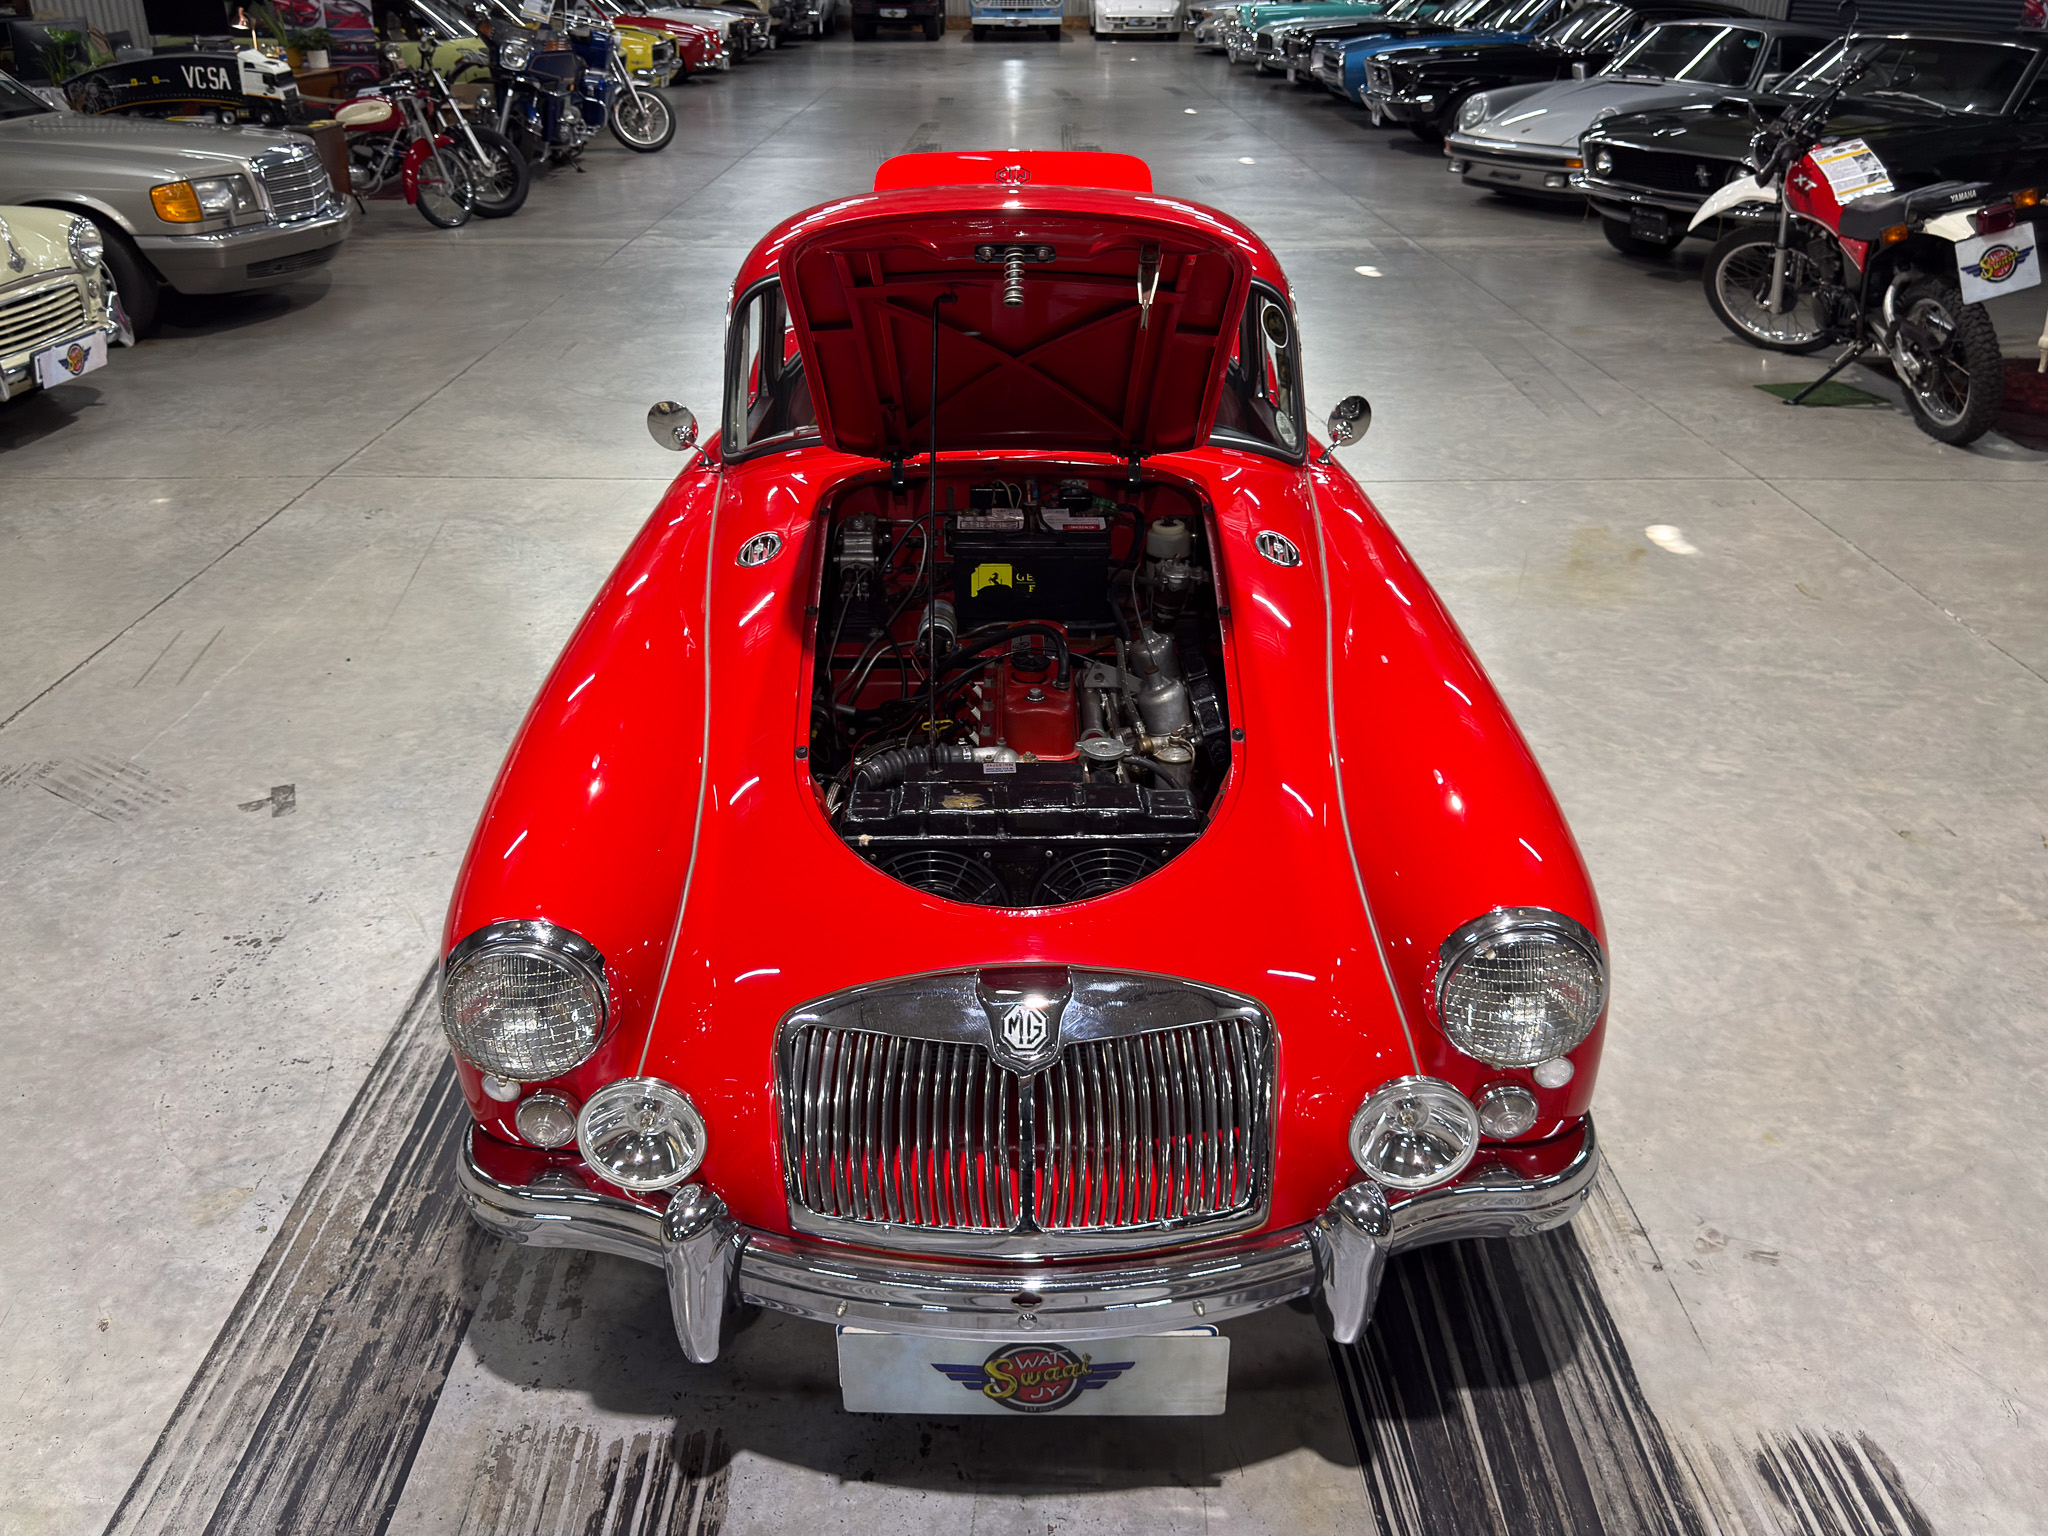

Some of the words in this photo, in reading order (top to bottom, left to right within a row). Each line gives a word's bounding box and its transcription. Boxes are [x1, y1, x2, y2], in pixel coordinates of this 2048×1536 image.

[180, 65, 232, 91] VCSA
[1793, 173, 1818, 191] XT
[1950, 189, 1977, 202] YAMAHA
[1007, 1007, 1044, 1046] MG
[1014, 1349, 1069, 1370] WAT
[983, 1352, 1093, 1399] Swaai
[1030, 1385, 1062, 1399] JY
